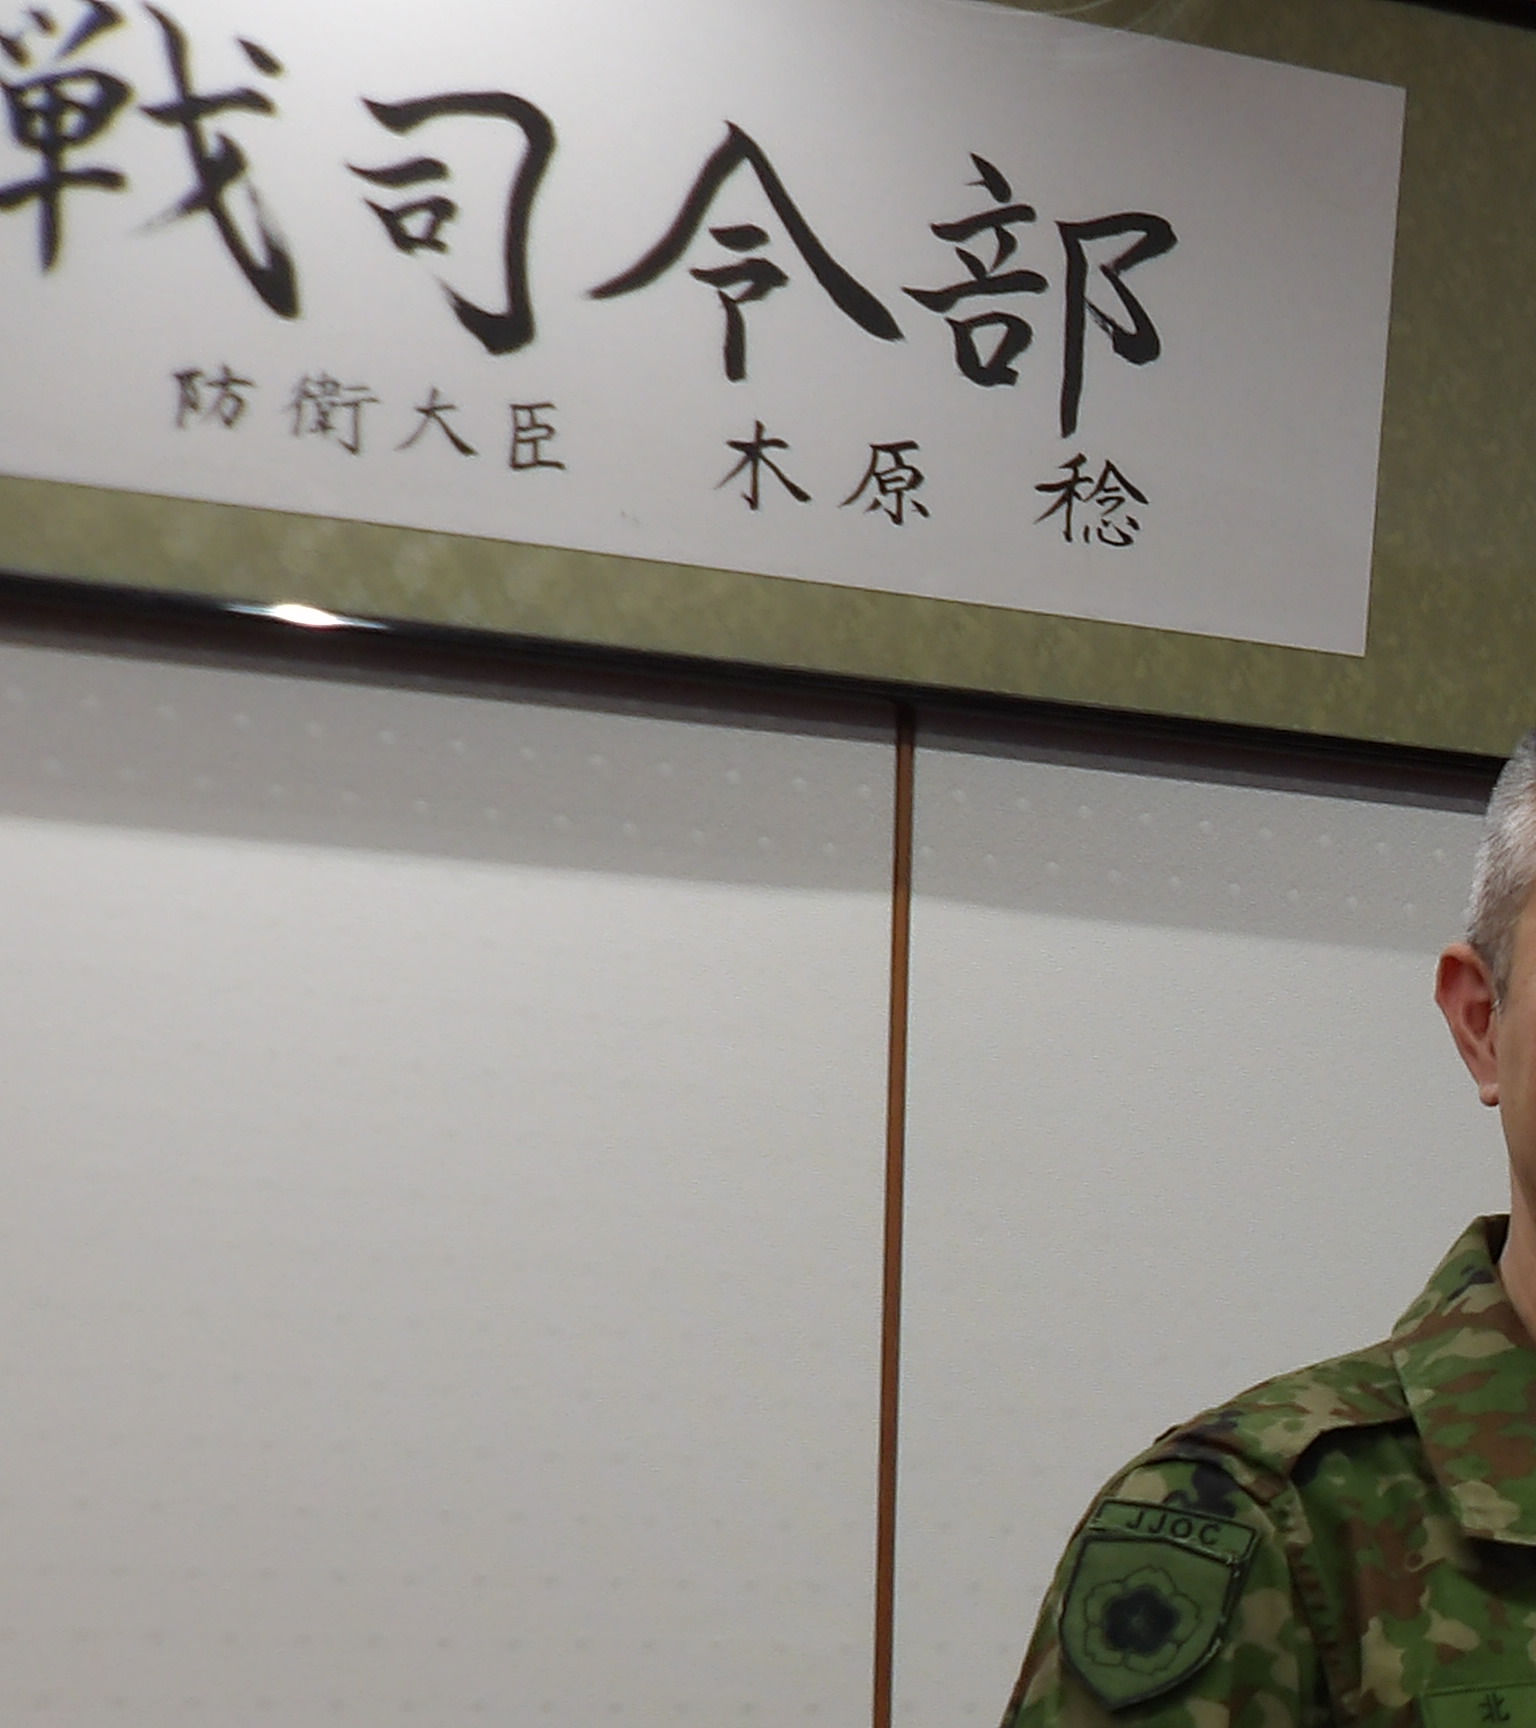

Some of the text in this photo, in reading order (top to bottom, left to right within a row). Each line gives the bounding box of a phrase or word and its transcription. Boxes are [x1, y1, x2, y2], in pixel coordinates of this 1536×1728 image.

[0, 0, 1179, 438] 戦司令部
[172, 364, 567, 472] 防衛大臣
[1126, 1511, 1223, 1547] JJOC
